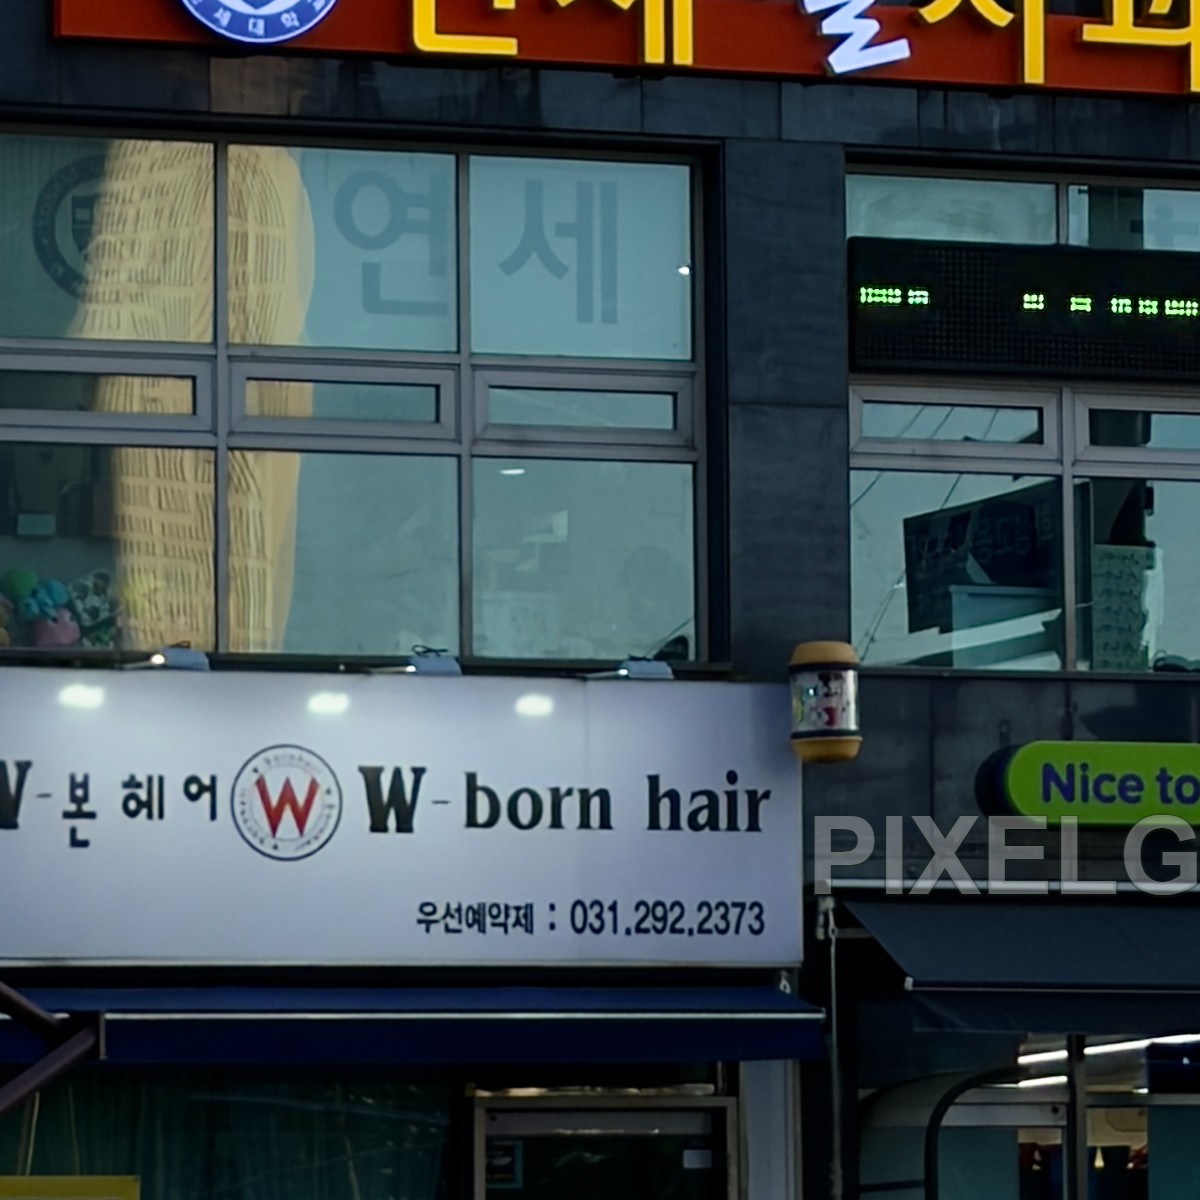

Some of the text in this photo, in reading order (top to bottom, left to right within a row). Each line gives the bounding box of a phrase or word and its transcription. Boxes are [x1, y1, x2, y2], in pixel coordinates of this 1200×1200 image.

[254, 774, 321, 840] W
[645, 769, 771, 833] hair
[1041, 762, 1145, 805] Nice
[416, 901, 534, 936] 우선예약제
[570, 899, 766, 937] 031.292.2373
